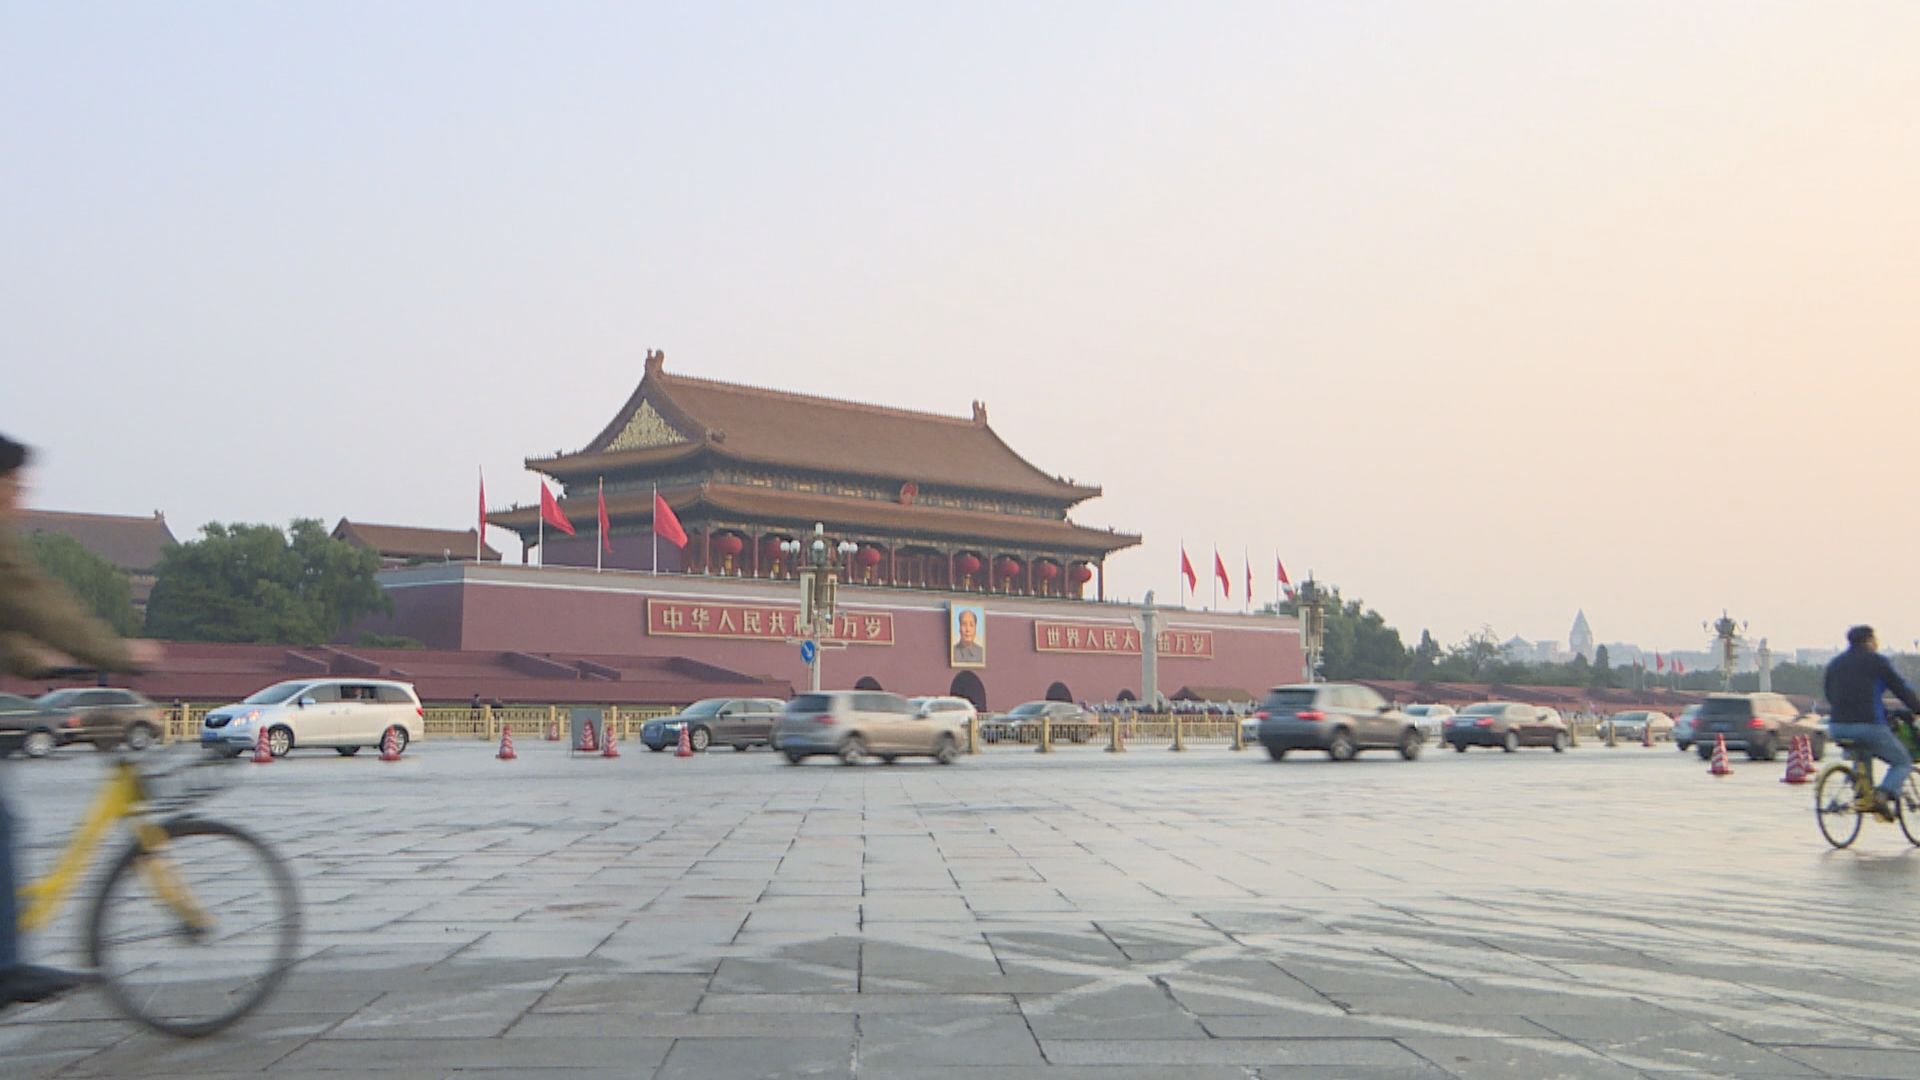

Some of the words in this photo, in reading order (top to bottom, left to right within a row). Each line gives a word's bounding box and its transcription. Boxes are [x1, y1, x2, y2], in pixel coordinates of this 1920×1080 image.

[1047, 625, 1204, 653] 世界人民大结万岁
